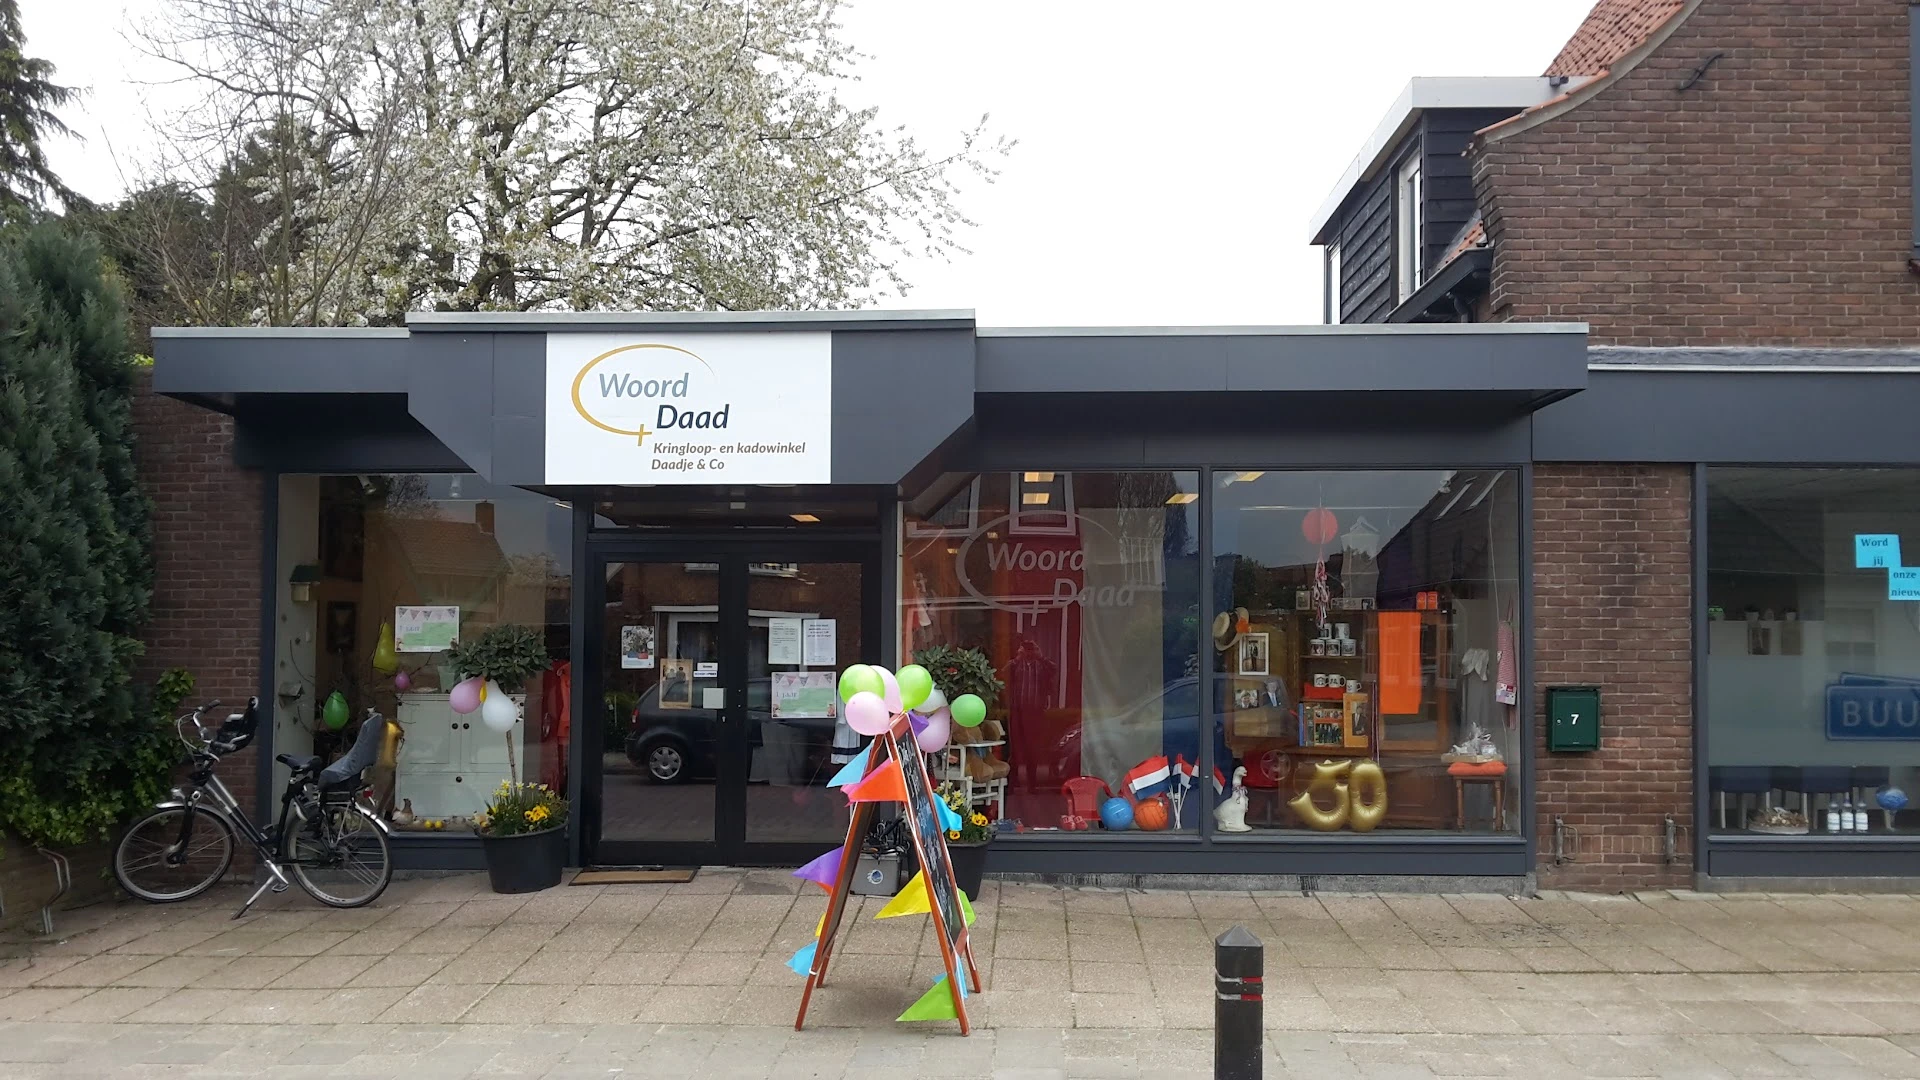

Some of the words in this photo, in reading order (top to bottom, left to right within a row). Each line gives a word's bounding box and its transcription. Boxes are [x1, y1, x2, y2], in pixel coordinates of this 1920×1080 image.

[599, 372, 689, 398] Woord
[656, 403, 730, 429] Daad
[653, 442, 717, 456] Kringloop-
[719, 445, 734, 454] en
[737, 442, 806, 454] kadowinkel
[651, 458, 694, 472] Daadje
[696, 459, 706, 470] &
[709, 458, 725, 470] Co
[1861, 538, 1888, 547] Word
[986, 541, 1087, 571] Woord
[1893, 571, 1917, 579] onze
[1052, 577, 1135, 607] Daad
[1571, 714, 1579, 725] 7
